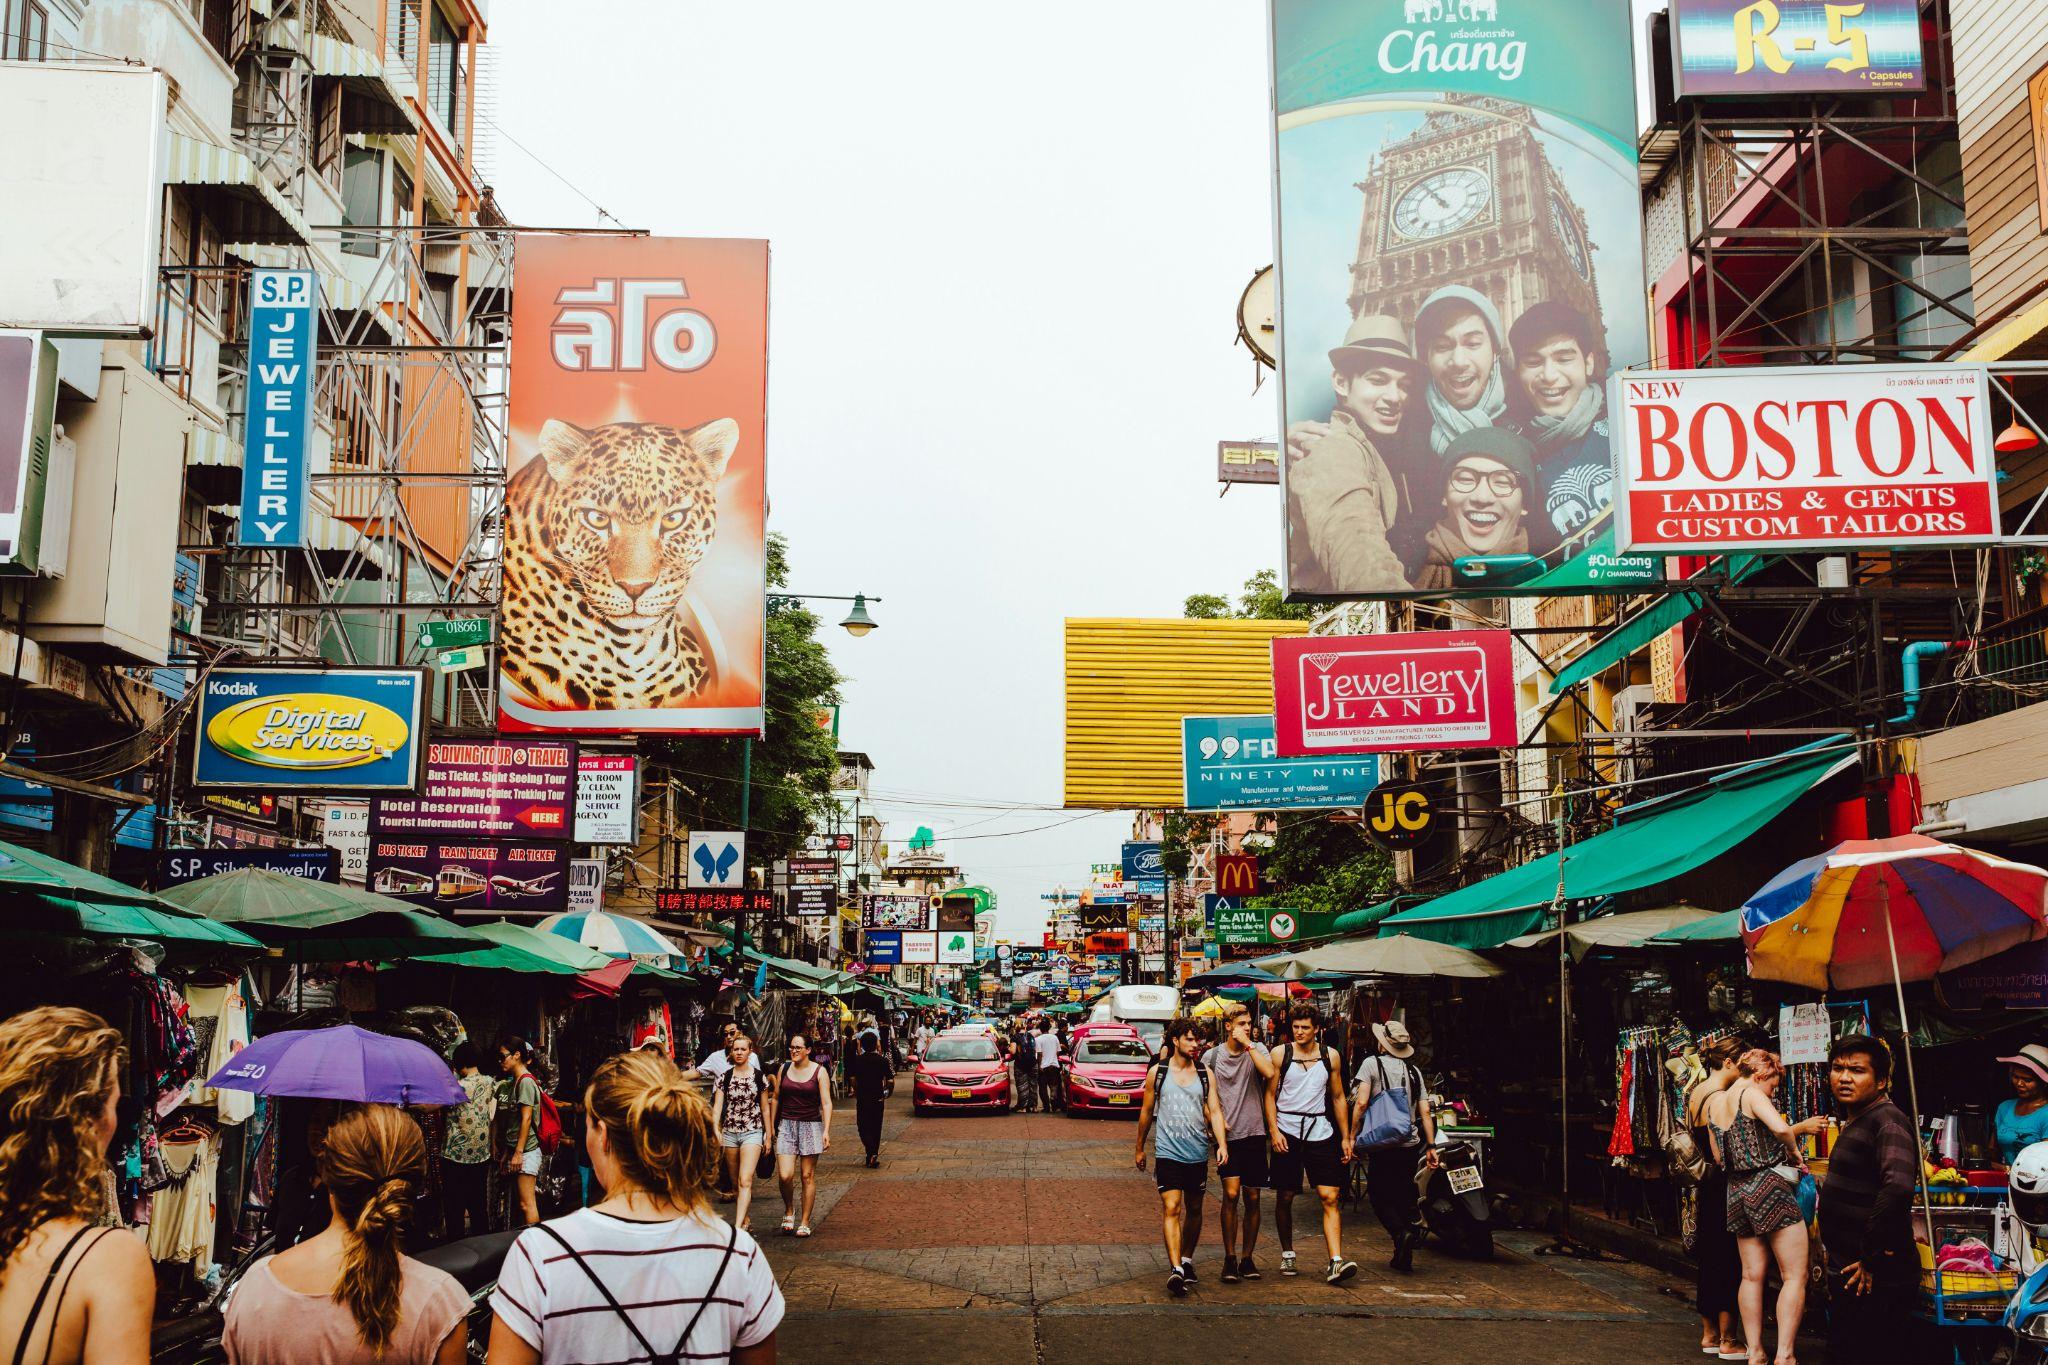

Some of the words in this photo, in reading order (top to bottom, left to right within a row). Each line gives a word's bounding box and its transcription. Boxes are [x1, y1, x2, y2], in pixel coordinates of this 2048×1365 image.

[1733, 0, 1869, 74] R-5
[1378, 29, 1527, 80] Chang
[1860, 71, 1866, 79] 4
[1869, 71, 1913, 81] Capsules
[262, 276, 305, 302] S.P.
[1630, 382, 1685, 400] NEW
[254, 312, 301, 542] JEWELLERY
[1630, 396, 1976, 482] BOSTON
[1662, 489, 1783, 513] LADIES
[1801, 489, 1826, 510] &
[1844, 487, 1957, 508] GENTS
[1656, 515, 1801, 538] CUSTOM
[1816, 511, 1967, 534] TAILORS
[1588, 554, 1652, 568] #OurSong
[418, 623, 431, 635] 01
[446, 620, 482, 633] 018661
[208, 680, 258, 696] Kodak
[1336, 697, 1456, 719] LAND
[265, 706, 367, 735] Digital
[251, 728, 375, 751] Services
[440, 744, 480, 764] DIVING
[481, 746, 513, 766] TOUR
[514, 749, 527, 765] &
[528, 748, 568, 767] TRAVEL
[448, 770, 481, 783] Ticket,
[482, 772, 507, 784] Sight
[509, 772, 542, 785] Seeing
[545, 774, 566, 784] Tour
[596, 774, 622, 782] ROOM
[1201, 770, 1291, 782] NINETY
[1313, 767, 1371, 777] NINE
[431, 786, 446, 797] Koh
[447, 786, 461, 797] Tao
[462, 787, 485, 798] Diving
[514, 789, 547, 801] Trekking
[548, 790, 566, 800] Tour
[1241, 786, 1280, 794] Manufacturer
[380, 801, 415, 812] Hotel
[421, 802, 501, 814] Reservation
[1371, 791, 1430, 833] JC
[380, 817, 416, 827] Tourist
[417, 818, 477, 829] Information
[479, 819, 514, 830] Center
[531, 812, 560, 824] HERE
[378, 844, 396, 857] BUS
[398, 845, 428, 858] TICKET
[439, 846, 467, 859] TRAIN
[468, 847, 498, 860] TICKET
[508, 849, 525, 861] AIR
[527, 849, 557, 862] TICKET
[170, 858, 206, 878] S.P.
[348, 859, 362, 868] 20
[1232, 913, 1256, 922] ATM
